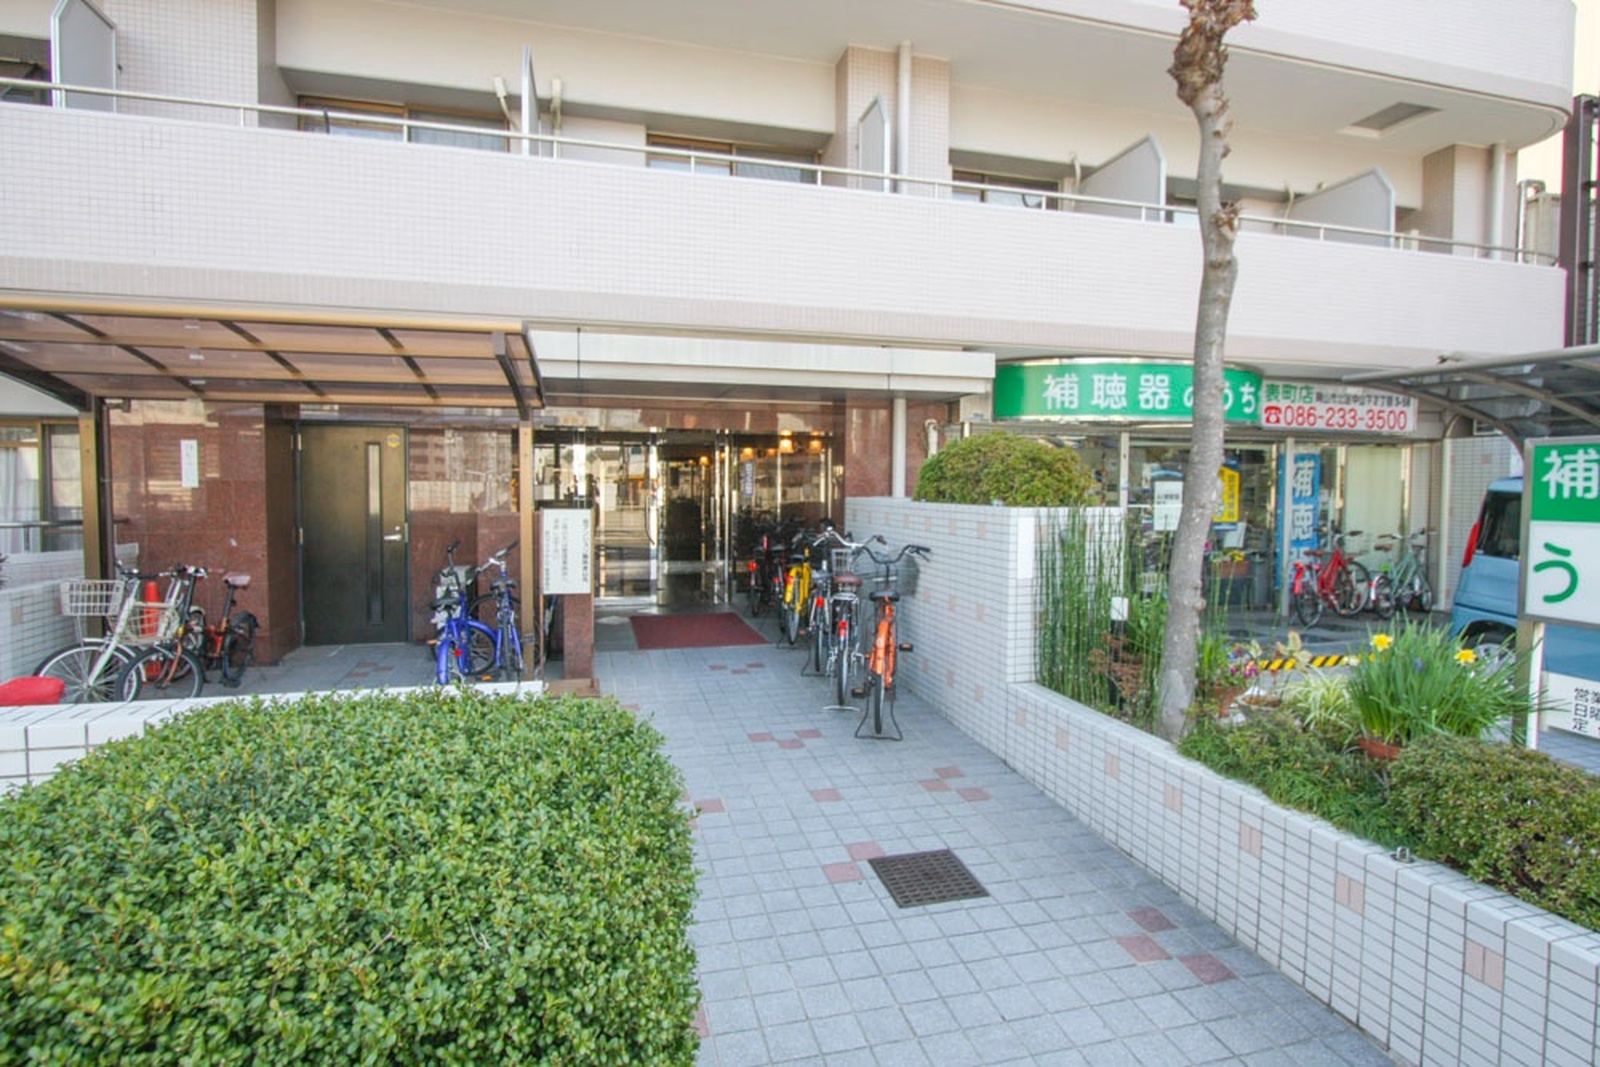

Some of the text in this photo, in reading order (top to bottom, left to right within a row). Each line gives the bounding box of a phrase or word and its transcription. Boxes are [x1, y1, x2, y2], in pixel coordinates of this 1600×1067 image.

[1265, 383, 1314, 403] 表町店
[1284, 405, 1407, 430] 086-233-3500
[1541, 448, 1600, 499] 補
[1533, 541, 1578, 603] う
